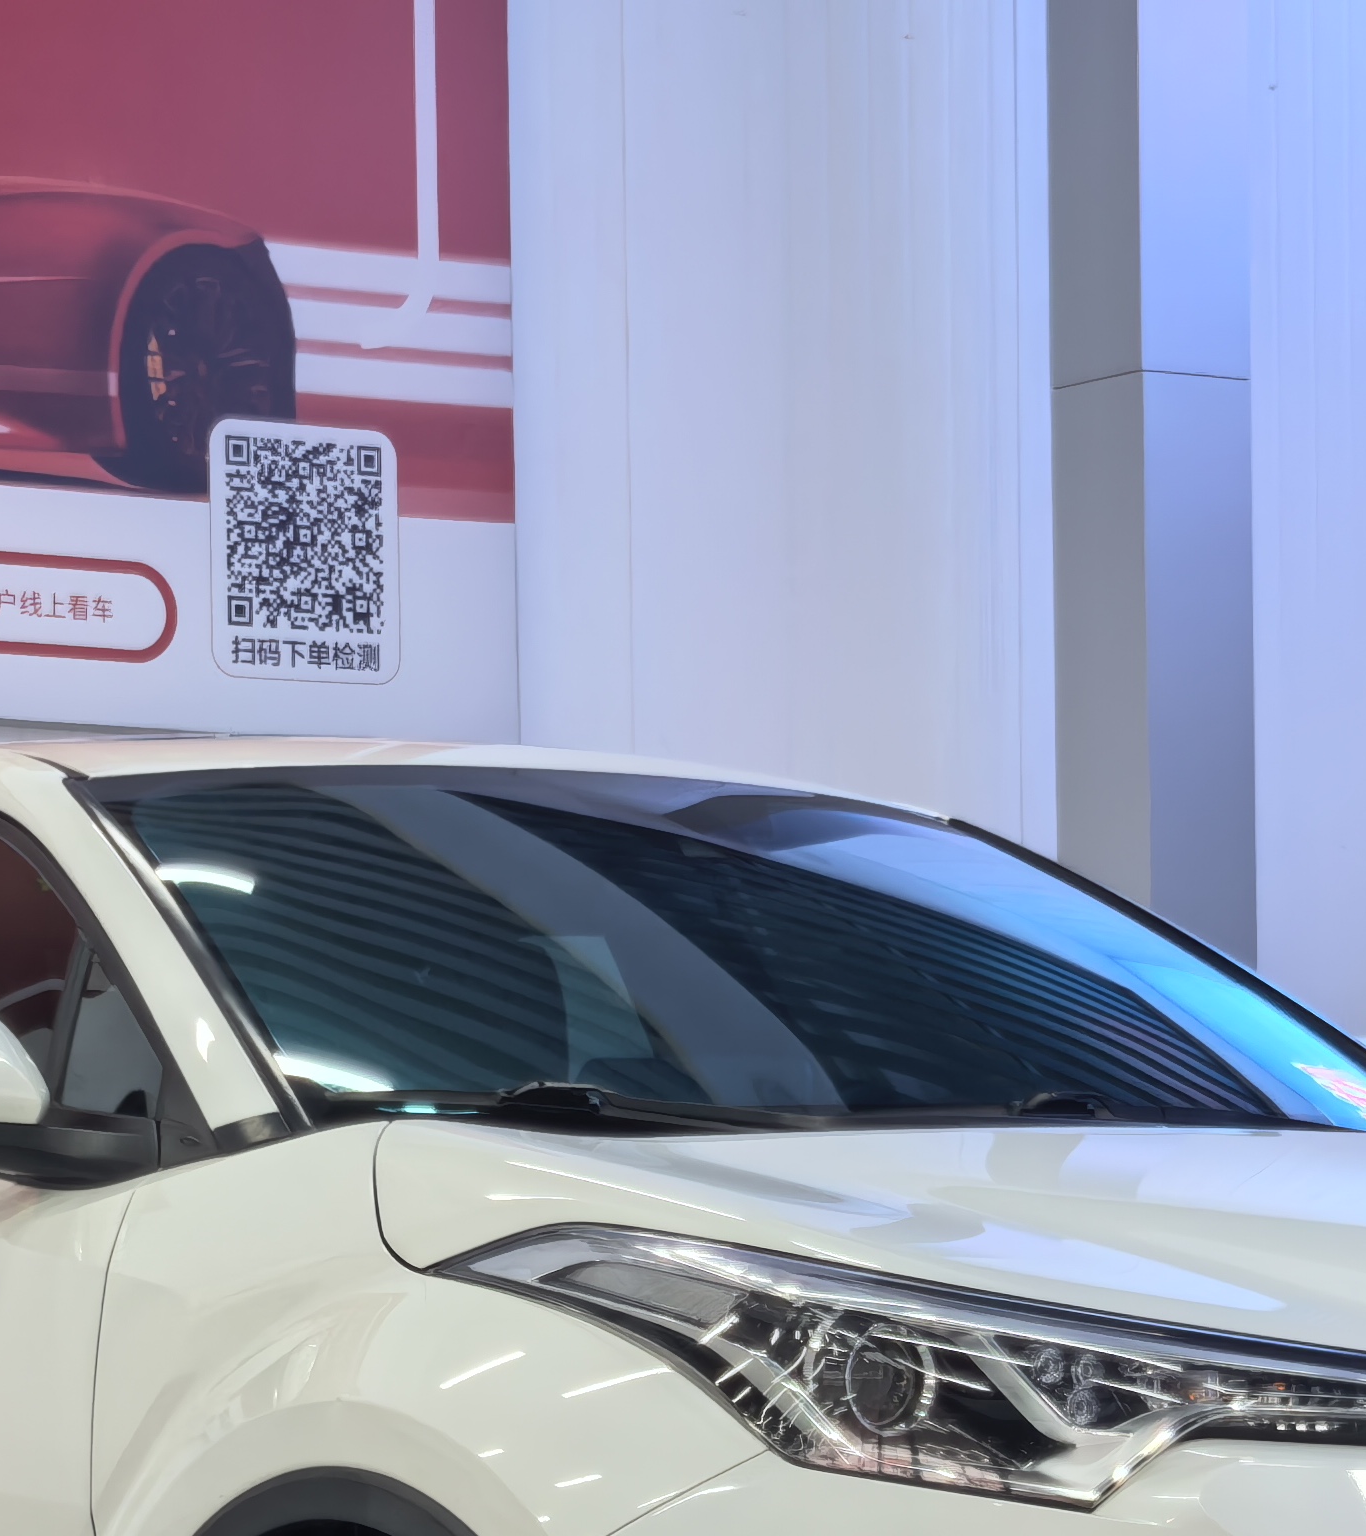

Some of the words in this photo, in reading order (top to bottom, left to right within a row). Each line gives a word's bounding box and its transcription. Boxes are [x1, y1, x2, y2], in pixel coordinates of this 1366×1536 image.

[231, 635, 380, 672] 扫码下单检测
